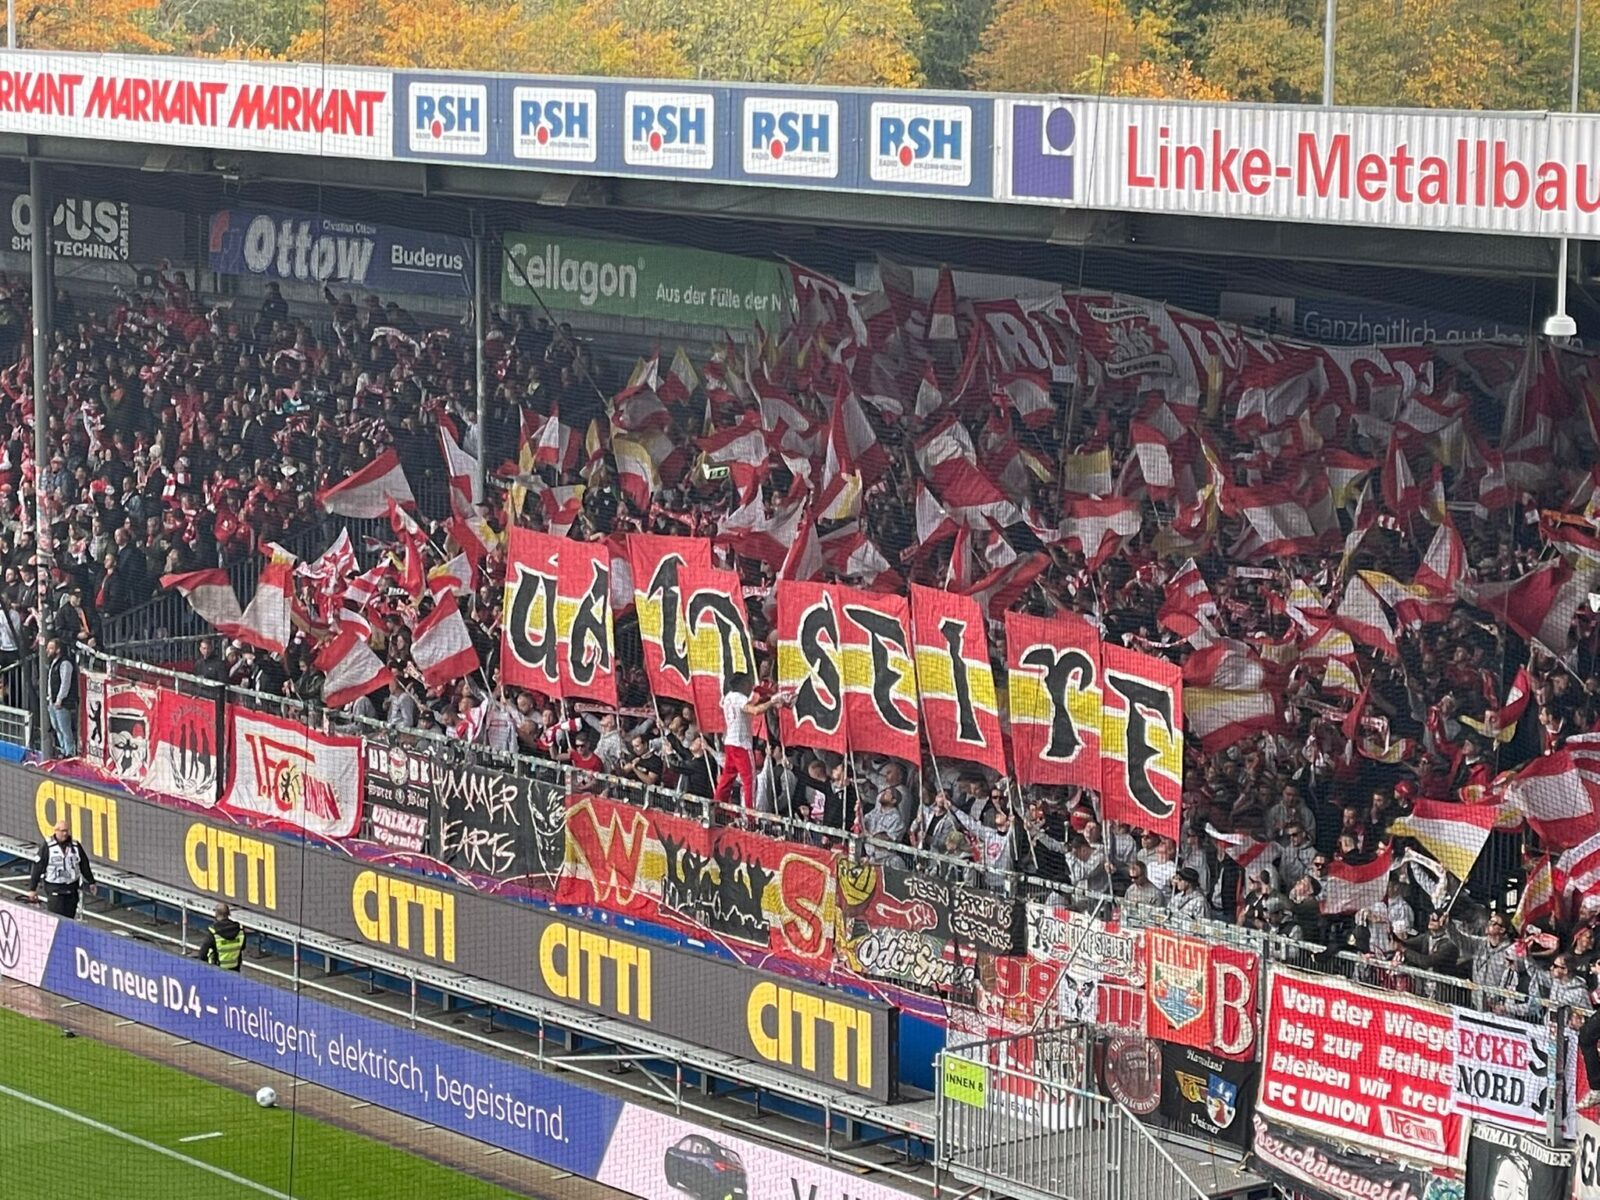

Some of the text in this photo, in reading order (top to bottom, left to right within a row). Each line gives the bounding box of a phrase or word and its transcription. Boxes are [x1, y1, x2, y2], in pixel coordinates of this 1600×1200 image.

[84, 76, 229, 127] MARKANT
[228, 84, 387, 137] MARKANT
[416, 95, 480, 133] RSH
[521, 100, 589, 139] RSH
[632, 104, 706, 145] RSH
[752, 111, 830, 153] RSH
[879, 116, 963, 161] RSH
[1127, 124, 1600, 214] Linke-Metallbau
[244, 214, 375, 285] Ottow
[391, 244, 464, 271] Buderus
[507, 243, 638, 305] Cellagon
[655, 283, 681, 304] Aus
[683, 284, 707, 306] der
[710, 287, 740, 310] Fülle
[745, 288, 769, 311] der
[1303, 310, 1437, 344] Ganzheitlich
[35, 779, 119, 863] CITTI
[371, 804, 429, 837] UNIKAT
[184, 822, 277, 911] CITTI
[352, 870, 457, 964] CITTI
[539, 921, 652, 1022] CITTI
[1280, 985, 1326, 1018] Von
[1330, 999, 1373, 1029] der
[75, 947, 106, 987] Der
[111, 968, 158, 1004] neue
[162, 976, 201, 1019] ID.4
[224, 996, 322, 1066] intelligent,
[328, 1033, 429, 1102] elektrisch,
[436, 1064, 569, 1143] begeisternd.
[747, 980, 873, 1090] CITTI
[1278, 1018, 1455, 1087] bis zur Bahre
[1458, 1027, 1529, 1071] ECKE
[946, 1072, 984, 1093] INNEN 8
[1268, 1080, 1371, 1128] FC UNION
[1271, 1051, 1453, 1116] bleiben wir treu
[1456, 1064, 1526, 1107] NORD
[1520, 1136, 1572, 1168] UNIONER
